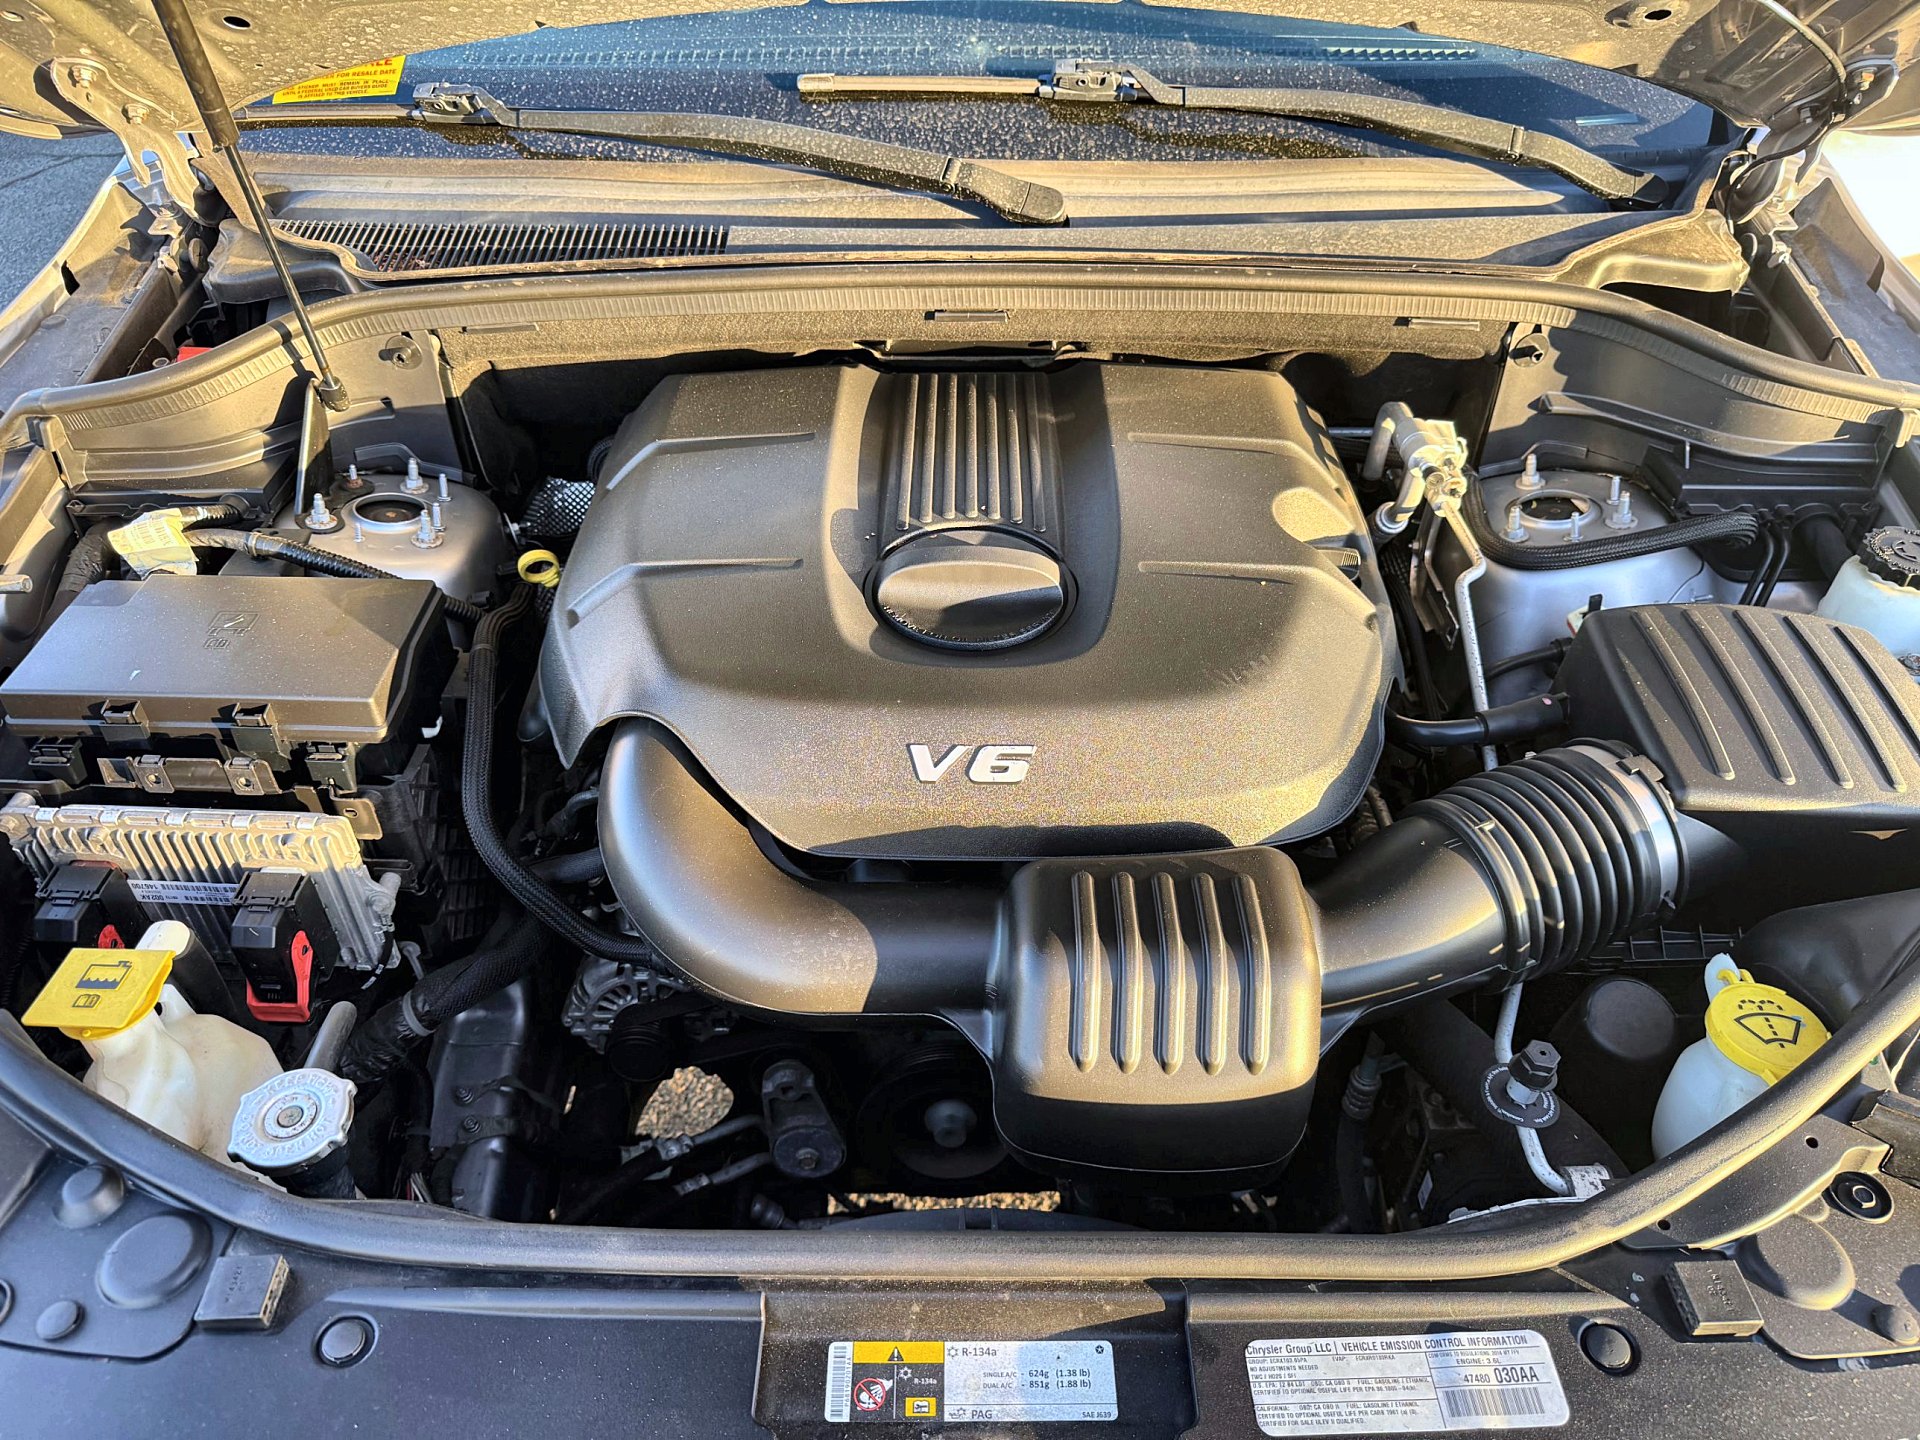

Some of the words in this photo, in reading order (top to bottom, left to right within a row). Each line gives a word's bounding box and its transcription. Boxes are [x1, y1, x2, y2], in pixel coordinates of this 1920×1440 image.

[906, 743, 1038, 784] V6
[1246, 1345, 1282, 1356] Chrysler
[1285, 1344, 1312, 1355] Group
[1314, 1342, 1332, 1353] LLC
[1341, 1341, 1378, 1352] VEHICLE
[1380, 1340, 1422, 1351] EMISSION
[1424, 1337, 1466, 1350] CONTROL
[1467, 1335, 1528, 1347] INFORMATION
[961, 1347, 997, 1357] R-134a
[1456, 1357, 1485, 1365] ENGINE:
[1005, 1371, 1017, 1379] A/C
[1028, 1369, 1049, 1379] 624g
[1055, 1368, 1077, 1379] (1.38
[1079, 1368, 1091, 1379] lb)
[1463, 1374, 1491, 1384] 47480
[1493, 1366, 1540, 1384] 030AA
[999, 1382, 1013, 1390] A/C
[1029, 1380, 1050, 1390] 851g
[1056, 1379, 1078, 1390] (1.88
[1079, 1379, 1092, 1390] lb)
[971, 1409, 993, 1419] PAG
[1082, 1411, 1096, 1419] SAE
[1096, 1411, 1112, 1419] J639
[1295, 1411, 1321, 1419] OPTIONAL
